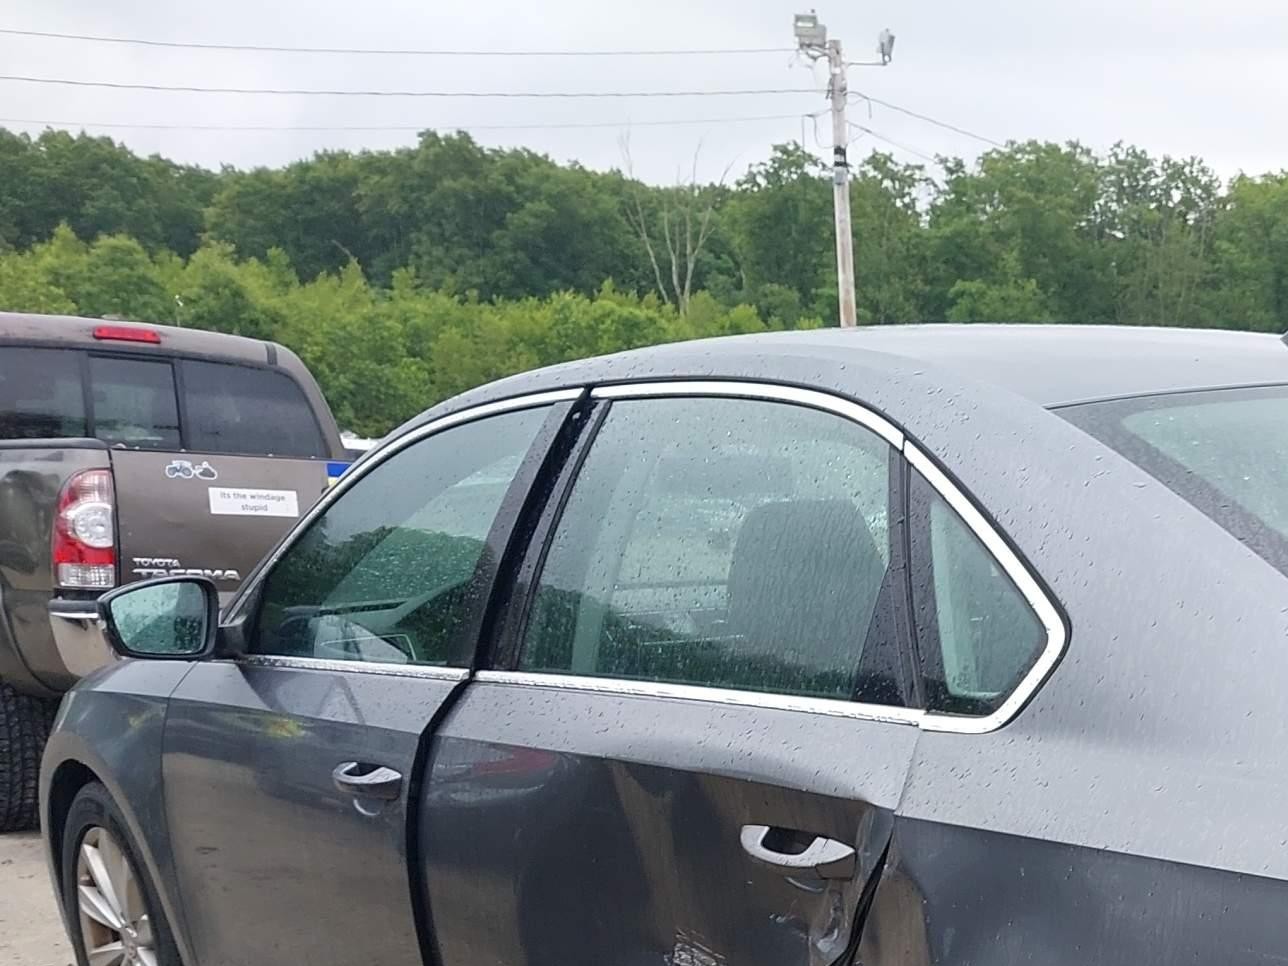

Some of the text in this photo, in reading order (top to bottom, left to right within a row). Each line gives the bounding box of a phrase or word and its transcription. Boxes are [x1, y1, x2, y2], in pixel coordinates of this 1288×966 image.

[233, 491, 247, 500] the
[249, 493, 286, 502] windage
[241, 503, 268, 512] stupid
[132, 557, 181, 567] TOYOTA
